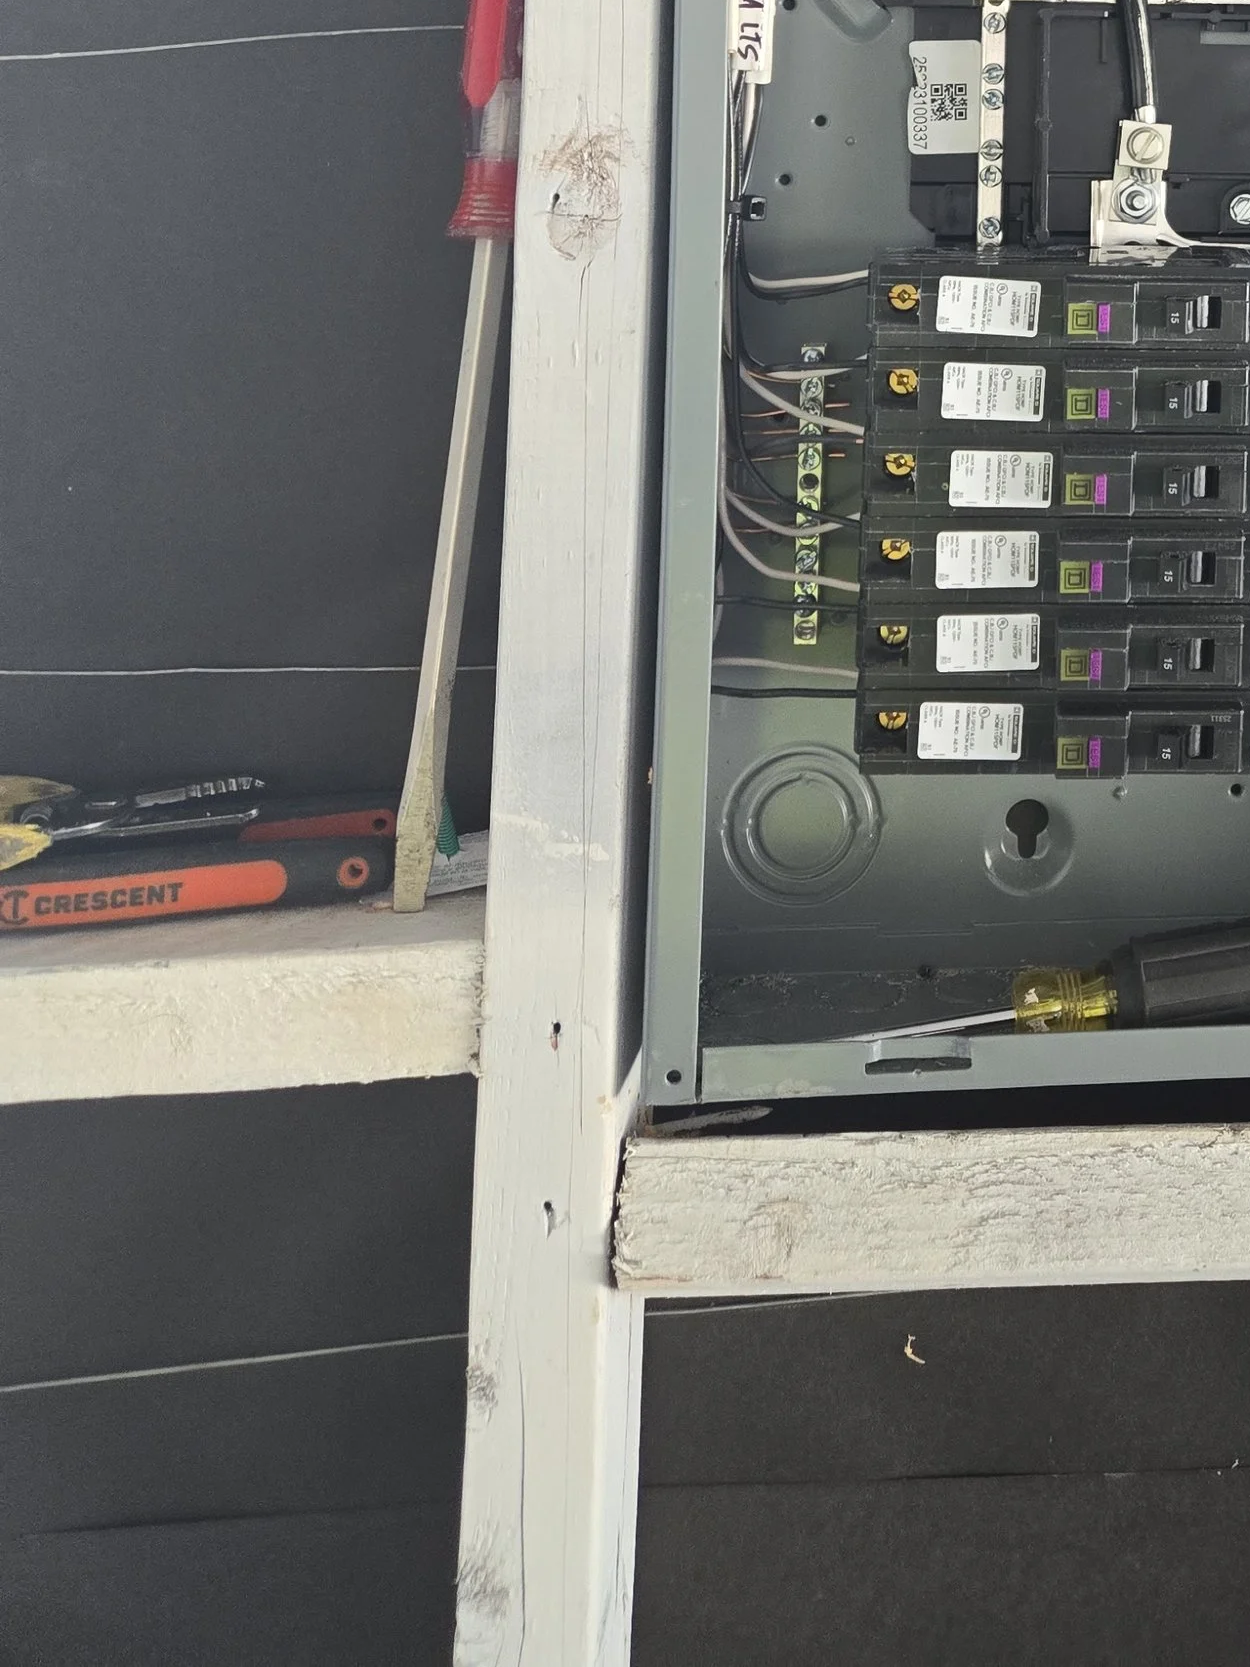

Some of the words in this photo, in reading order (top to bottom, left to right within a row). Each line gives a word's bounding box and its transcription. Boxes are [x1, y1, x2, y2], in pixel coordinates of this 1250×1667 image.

[737, 22, 762, 62] LTS
[1170, 312, 1180, 325] 15
[1168, 397, 1178, 410] 15
[1168, 482, 1178, 495] 15
[1163, 570, 1173, 583] 15
[1163, 658, 1173, 671] 15
[1161, 747, 1171, 761] 15
[34, 881, 183, 916] CRESCENT
